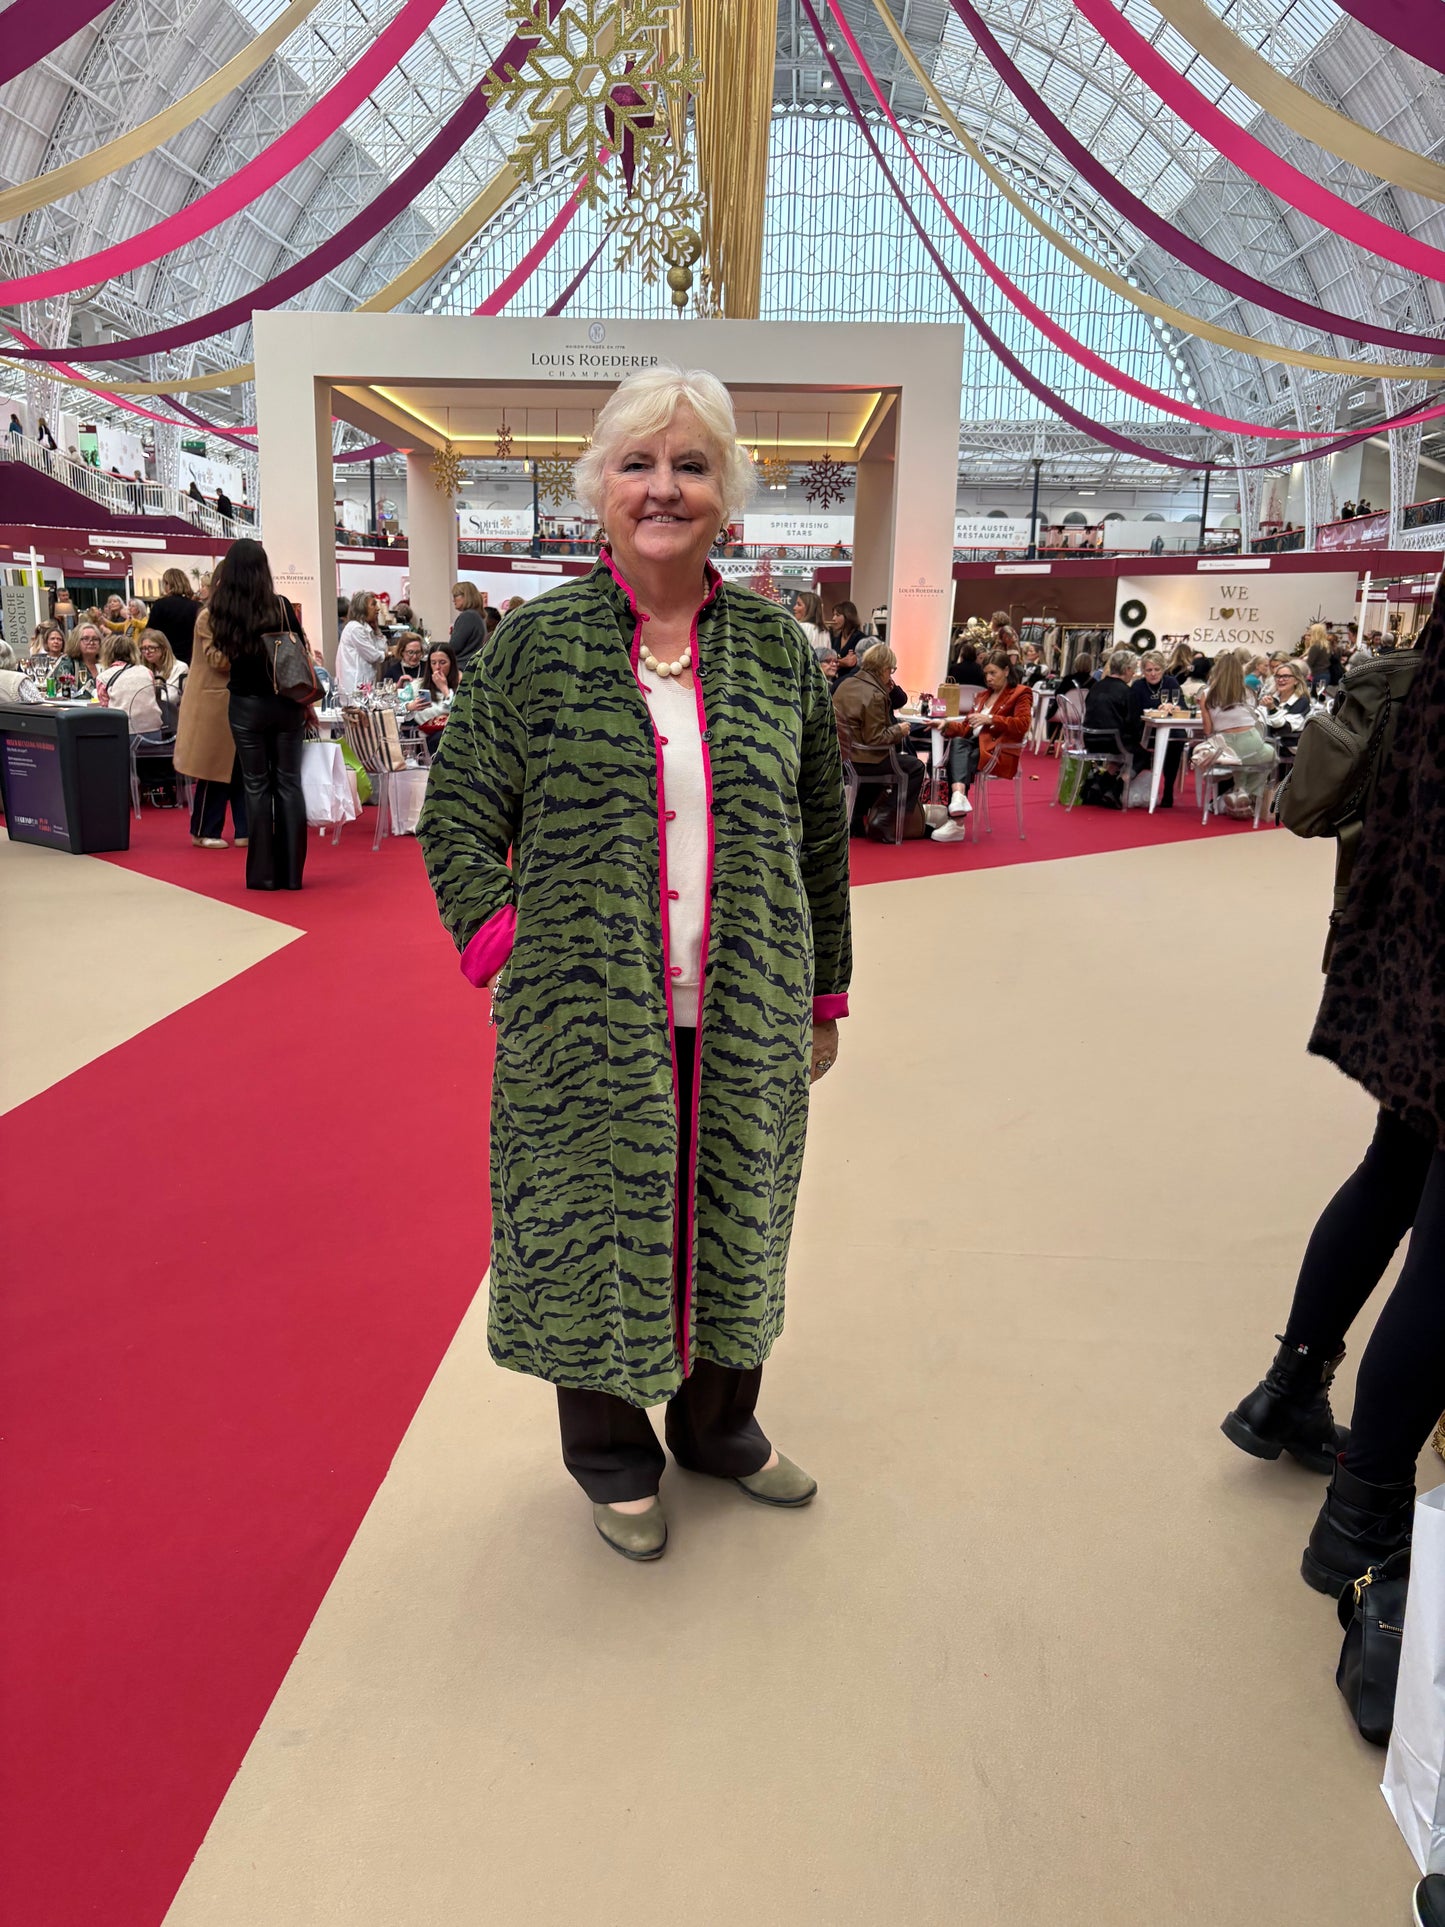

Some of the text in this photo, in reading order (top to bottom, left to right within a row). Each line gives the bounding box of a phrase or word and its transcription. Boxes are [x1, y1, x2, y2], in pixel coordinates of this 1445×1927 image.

[531, 353, 658, 367] LOUIS ROEDERER
[548, 370, 632, 378] CHAMPAGN
[1220, 585, 1249, 600] WE
[7, 593, 19, 643] BRANCHE
[1193, 628, 1275, 644] SEASONS
